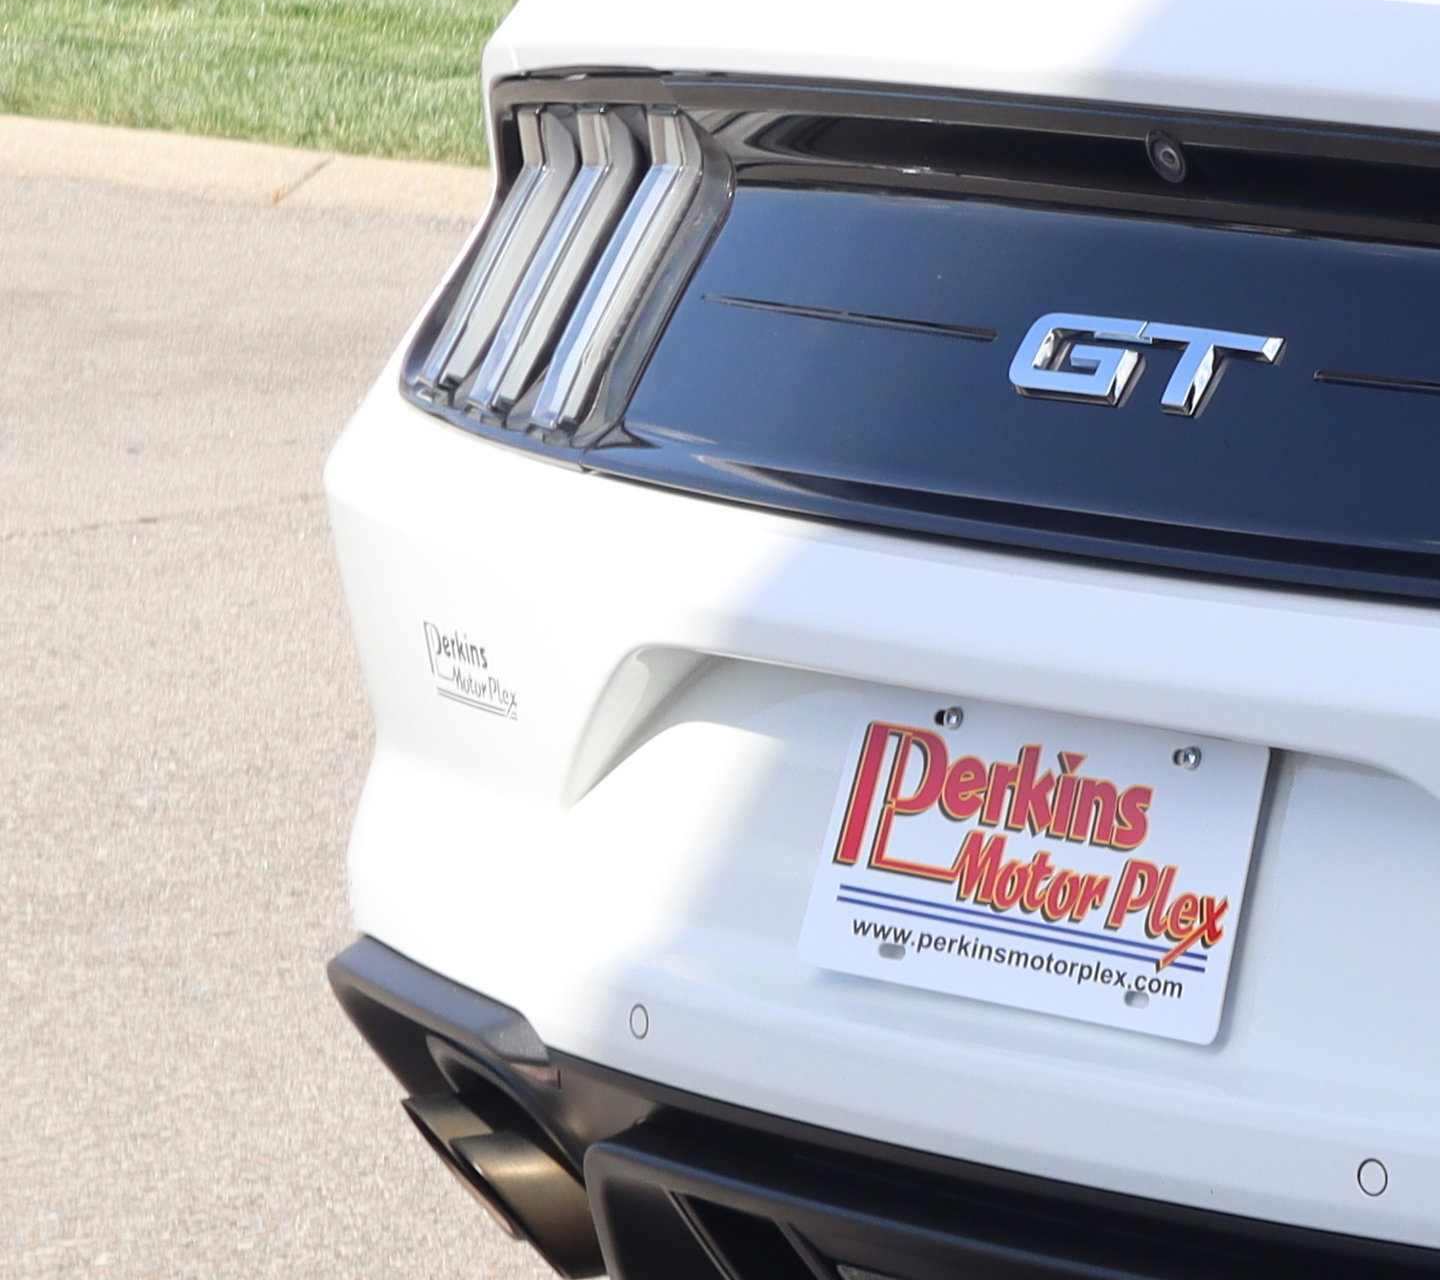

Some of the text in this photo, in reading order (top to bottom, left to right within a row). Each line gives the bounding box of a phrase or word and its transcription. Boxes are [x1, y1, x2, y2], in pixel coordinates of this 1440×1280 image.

[1008, 312, 1286, 417] GT
[423, 620, 488, 675] Perkins
[833, 720, 1155, 869] Perkins
[954, 828, 1230, 972] Motor Plex
[851, 918, 1185, 1000] www.perkinsmotorplex.com
